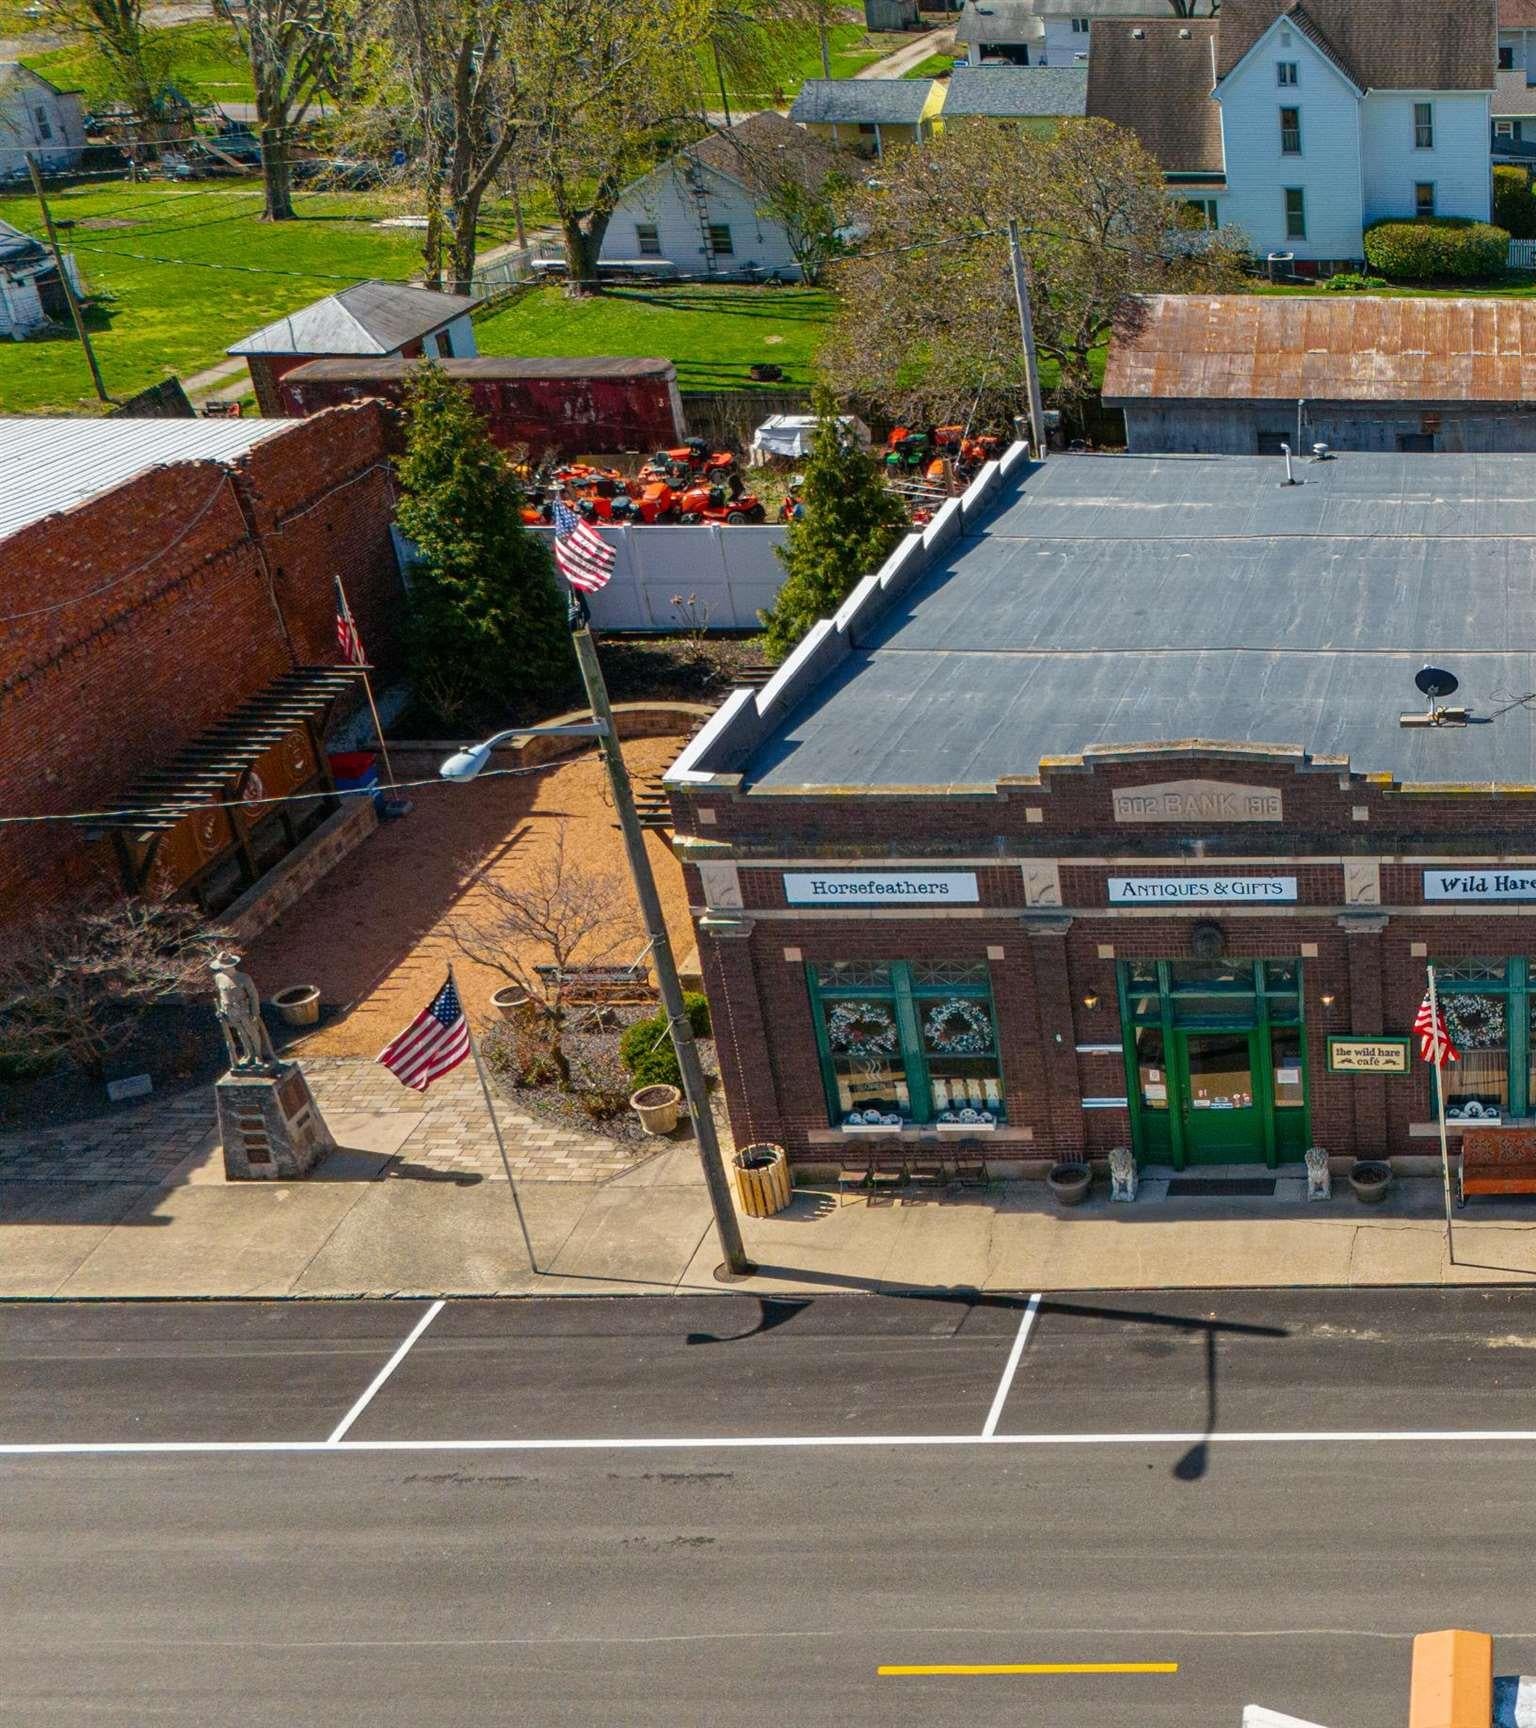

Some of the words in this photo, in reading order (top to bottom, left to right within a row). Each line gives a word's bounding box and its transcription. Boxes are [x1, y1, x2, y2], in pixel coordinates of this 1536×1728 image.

[1115, 796, 1159, 816] 1902
[1163, 792, 1238, 816] BANK
[810, 880, 950, 895] Horsefeathers
[1122, 882, 1209, 897] ANTIQUES
[1213, 882, 1229, 895] &
[1231, 881, 1284, 895] GIFTS
[1441, 876, 1488, 893] Wild
[1336, 1047, 1352, 1056] the
[1354, 1047, 1376, 1057] wild
[1377, 1047, 1401, 1057] hare
